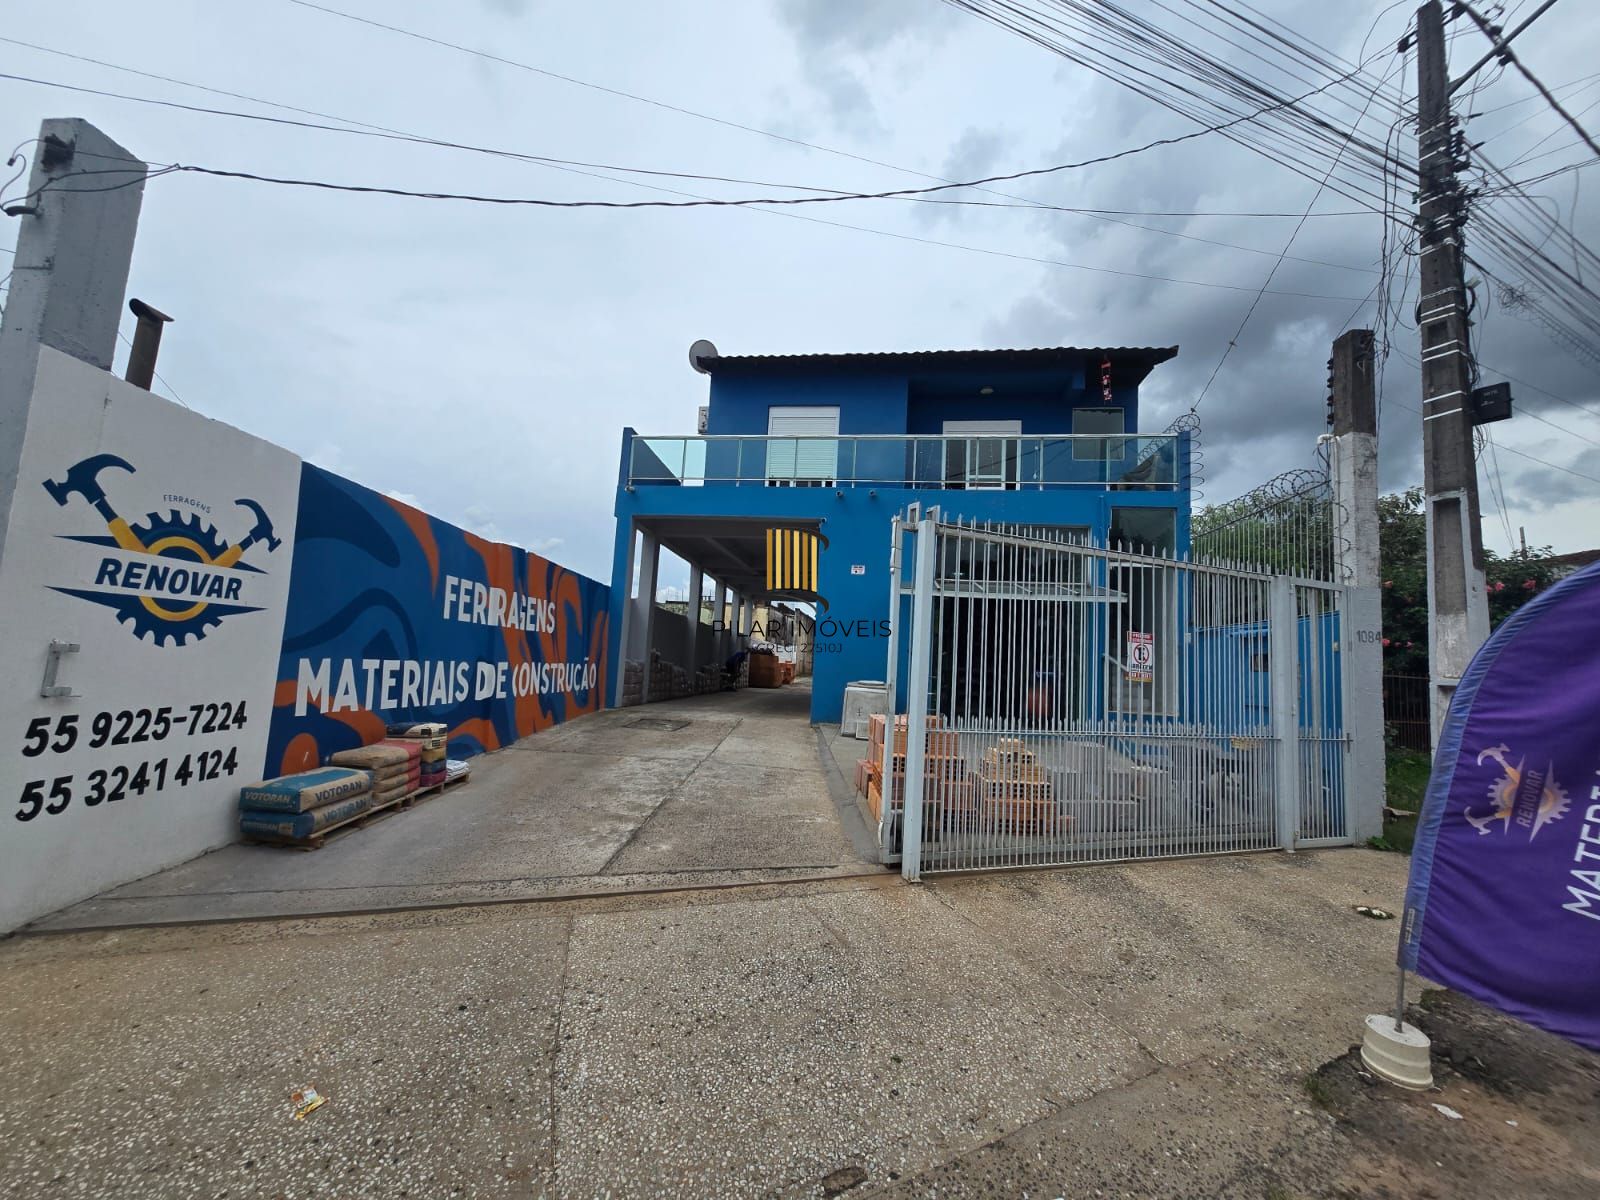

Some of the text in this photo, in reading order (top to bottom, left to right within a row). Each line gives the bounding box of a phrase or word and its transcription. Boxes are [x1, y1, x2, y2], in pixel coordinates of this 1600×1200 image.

[163, 494, 212, 514] FERRAGENS
[95, 558, 242, 600] RENOVAR
[443, 575, 556, 634] FERRAGENS
[294, 657, 469, 717] MATERIAIS
[475, 661, 508, 701] DE
[21, 700, 248, 757] 55 9225-7224
[15, 746, 238, 822] 55 3241 4124
[245, 791, 291, 803] VOTORAN
[315, 781, 362, 801] VOTORAN
[1516, 770, 1544, 828] RENOVAR
